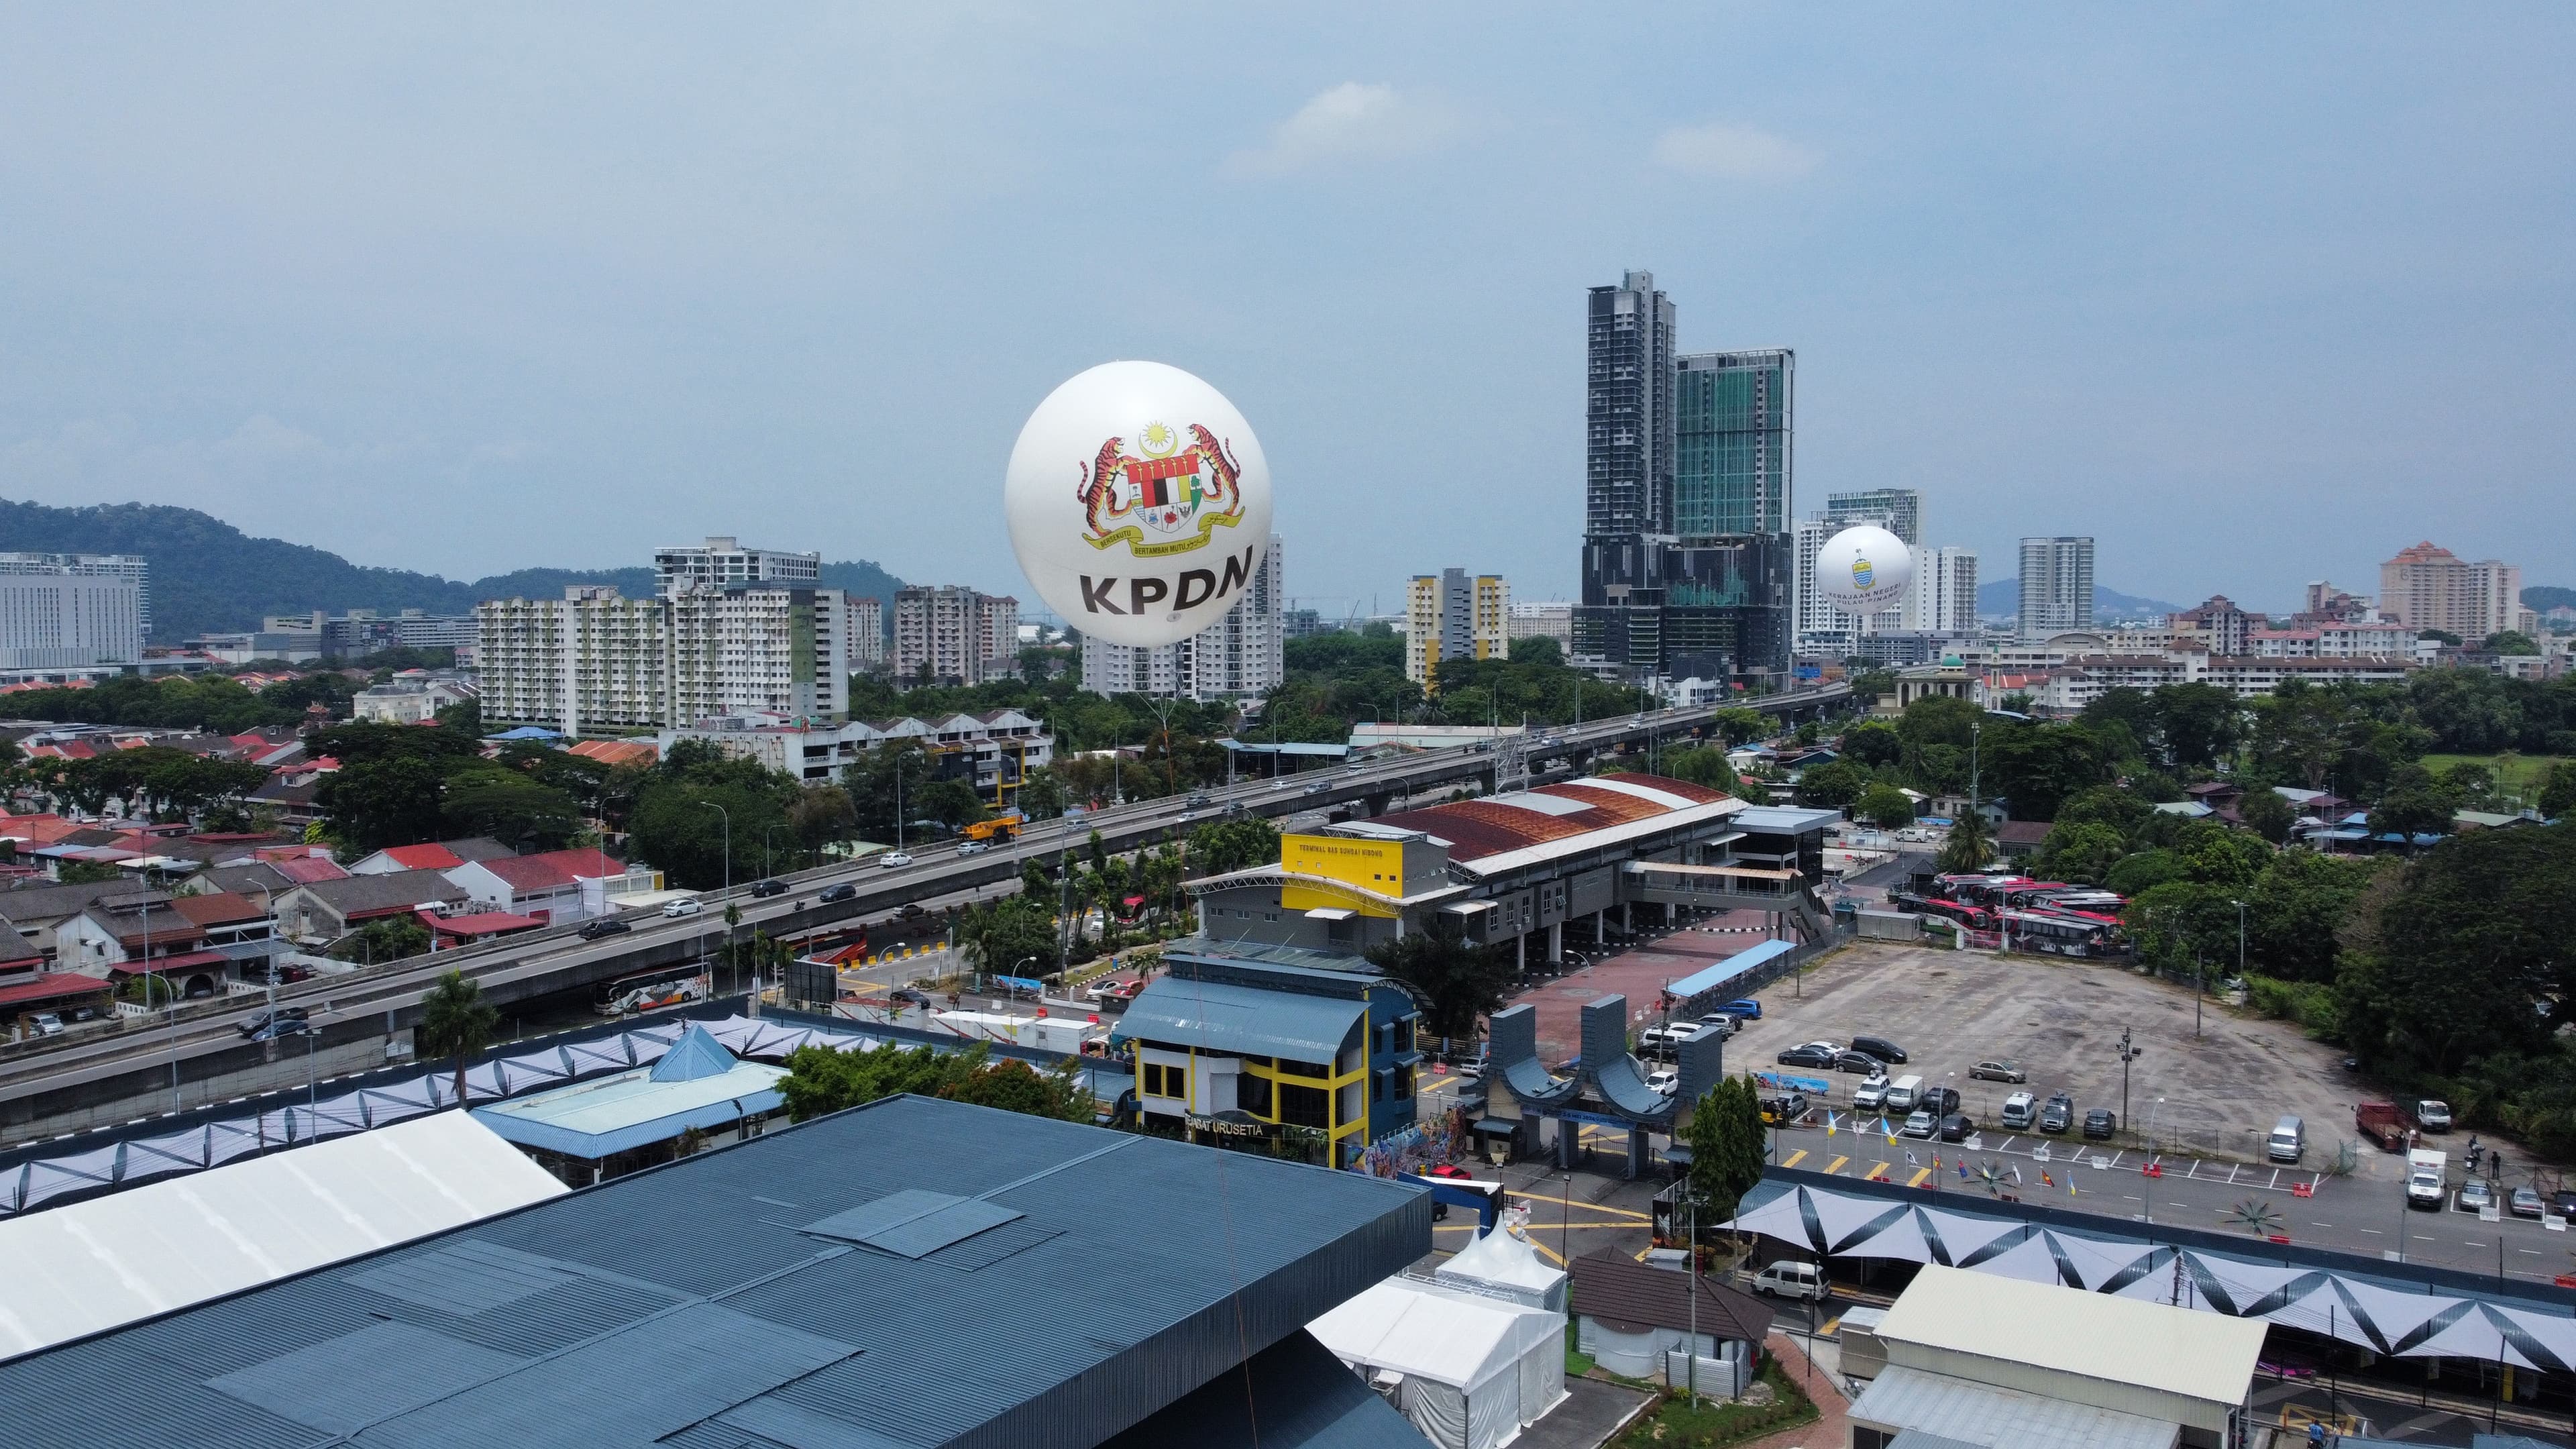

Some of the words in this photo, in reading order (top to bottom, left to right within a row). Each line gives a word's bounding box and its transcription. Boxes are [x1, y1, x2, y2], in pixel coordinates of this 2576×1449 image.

[1100, 530, 1132, 547] BERSEKUTU
[1134, 545, 1169, 555] BERTAMBAH
[1169, 544, 1187, 553] MUTU
[1079, 544, 1253, 615] KPDN
[1829, 592, 1870, 600] KERAJAAN
[1873, 582, 1900, 596] NEGERI
[1868, 590, 1899, 603] PINANG
[1299, 845, 1326, 853] TERMINAL
[1340, 847, 1360, 855] SUNGAI
[1362, 849, 1383, 857] NIBONG
[1213, 1122, 1263, 1136] URUSETIA
